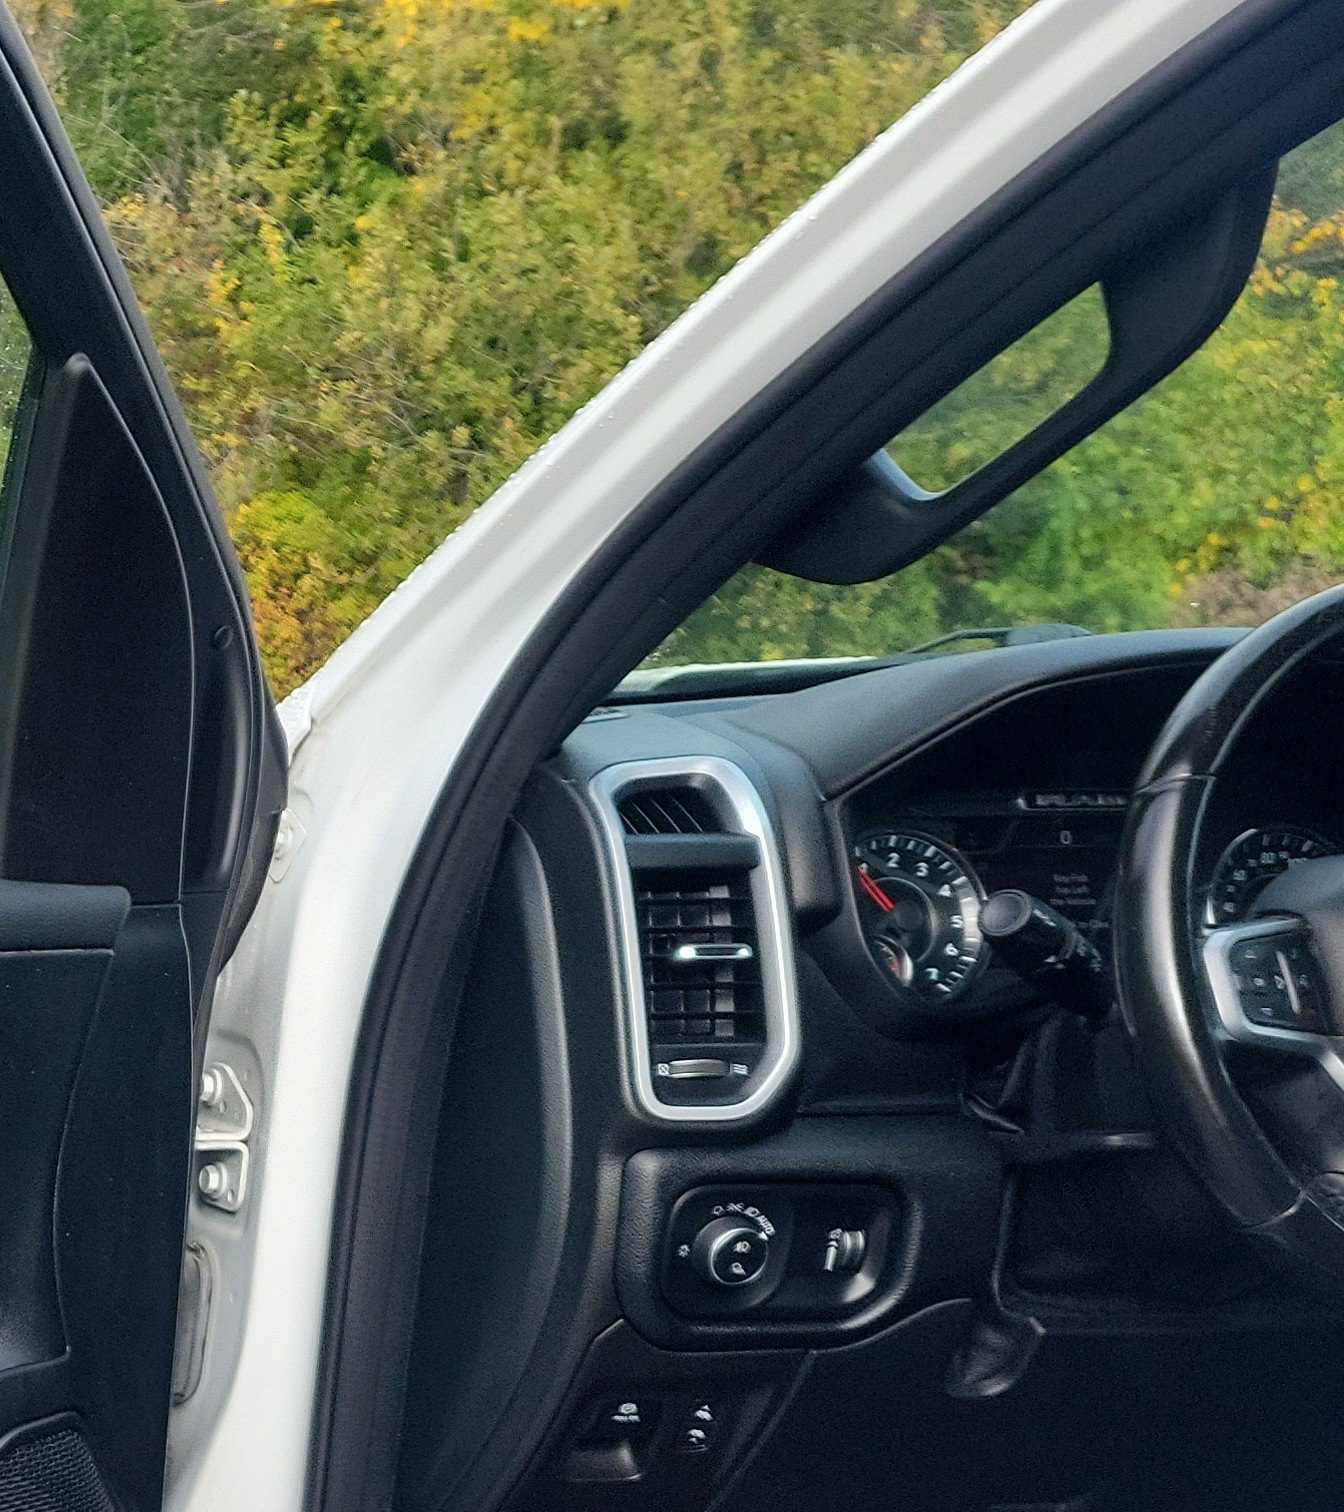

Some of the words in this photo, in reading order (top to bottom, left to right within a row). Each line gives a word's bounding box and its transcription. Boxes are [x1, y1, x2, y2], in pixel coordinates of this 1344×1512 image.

[886, 852, 900, 868] 2
[915, 862, 930, 877] 3
[944, 942, 959, 956] 6
